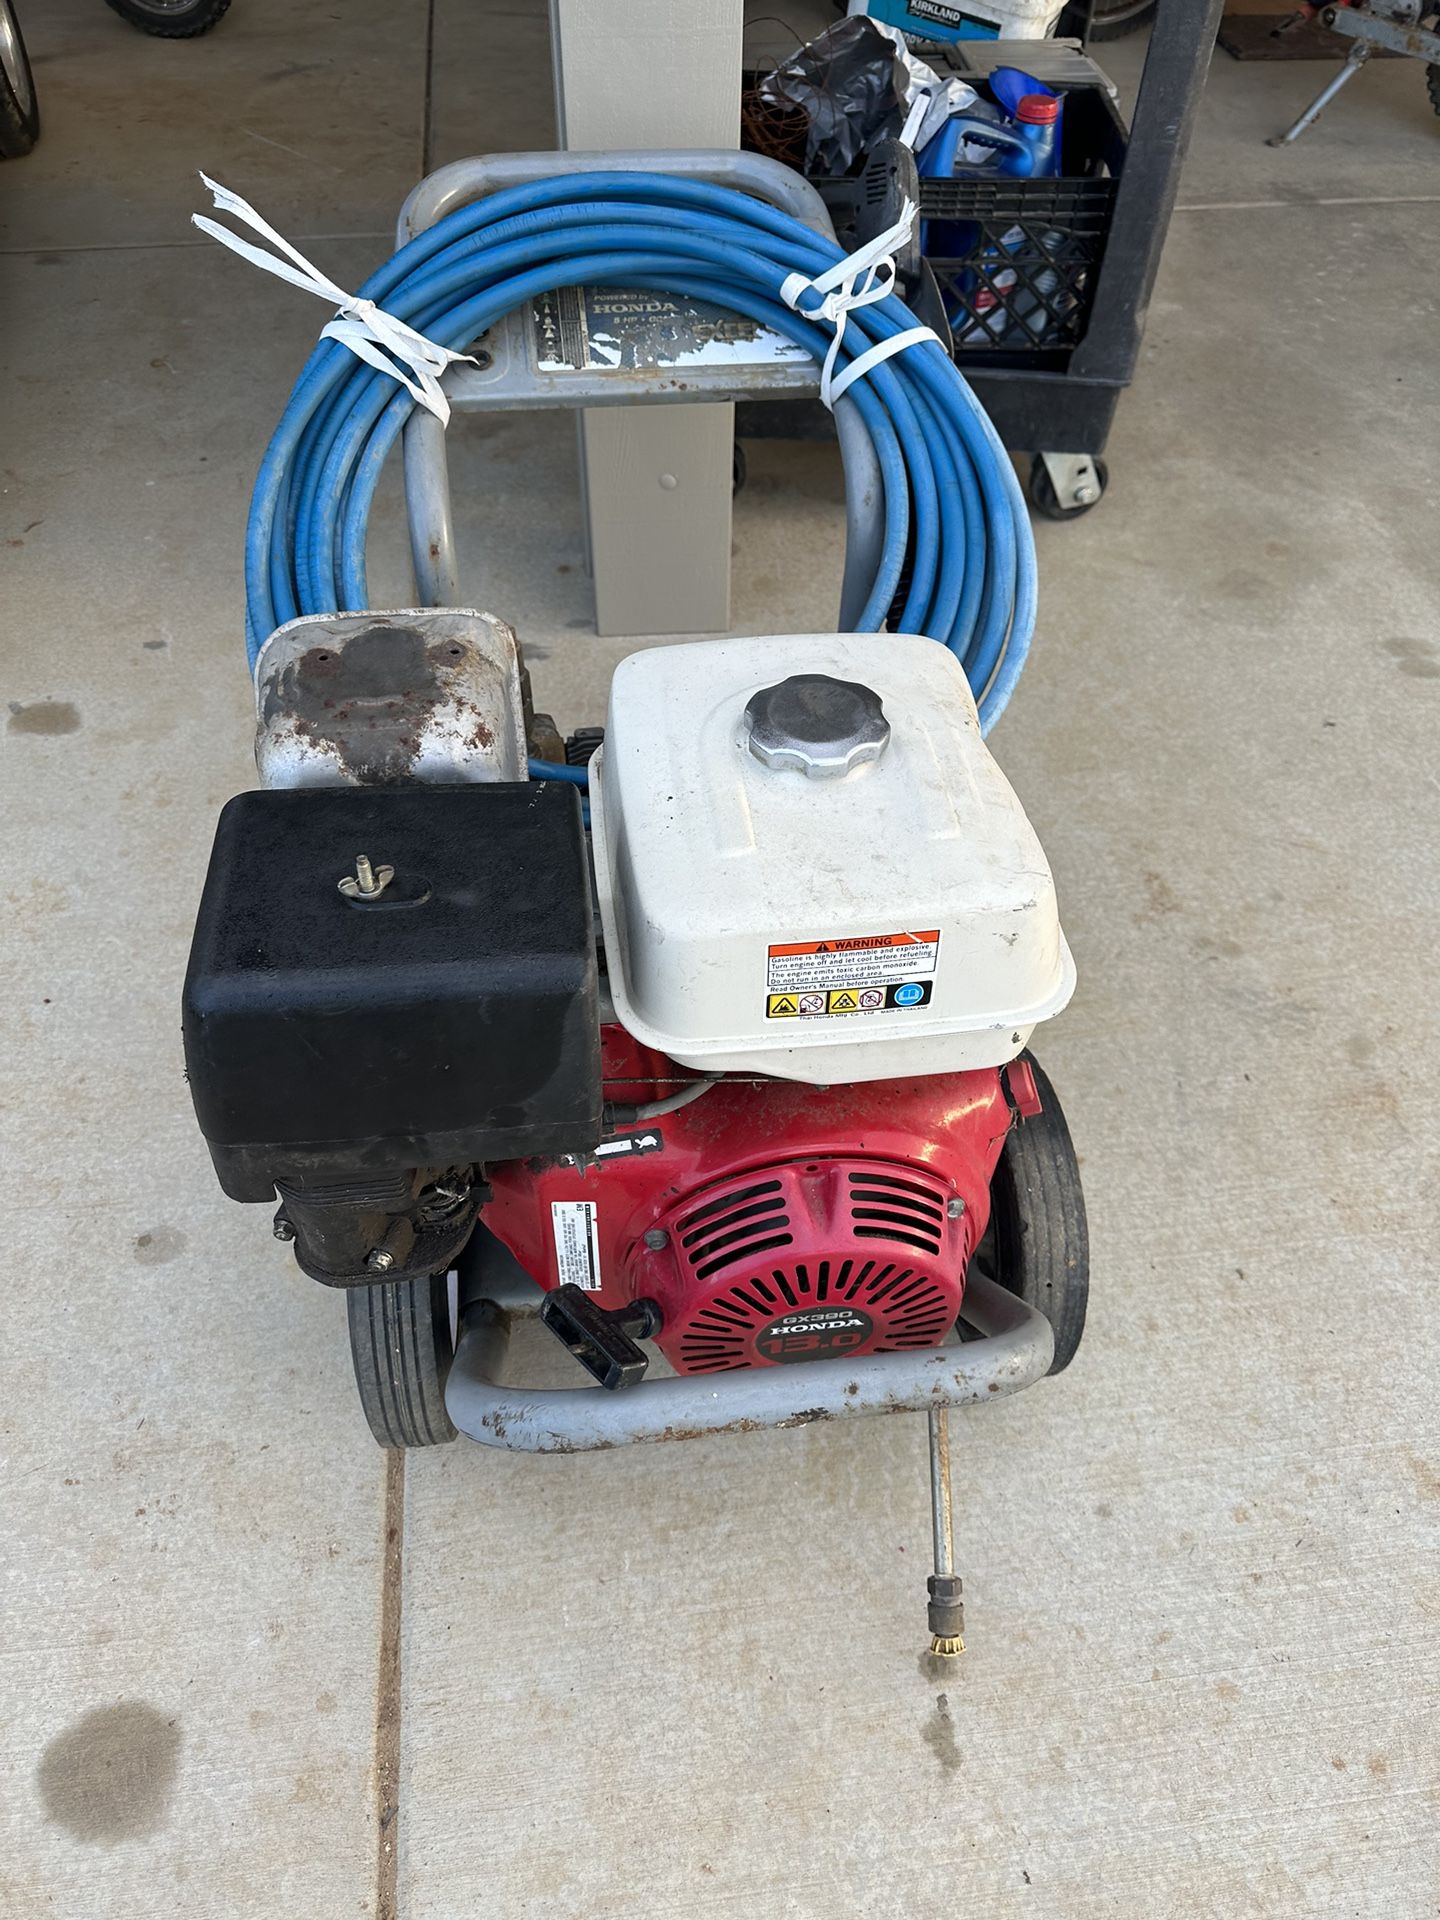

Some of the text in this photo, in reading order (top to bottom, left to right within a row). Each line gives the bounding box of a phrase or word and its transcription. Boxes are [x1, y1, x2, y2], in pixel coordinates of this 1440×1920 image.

[910, 0, 960, 21] KIRKLAND
[592, 302, 680, 314] HONDA
[834, 938, 892, 949] WARNING
[771, 955, 803, 963] Gasoline
[814, 952, 837, 960] highly
[838, 950, 878, 958] flammable
[896, 945, 932, 953] explosive.
[787, 970, 812, 978] engine
[855, 964, 880, 972] carbon
[882, 961, 920, 969] monoxide.
[789, 961, 815, 969] engine
[789, 983, 817, 991] Owner's
[819, 981, 845, 989] Manual
[846, 979, 868, 987] before
[783, 1310, 853, 1325] GX390
[770, 1319, 864, 1335] HONDA
[761, 1333, 861, 1354] 13.0
